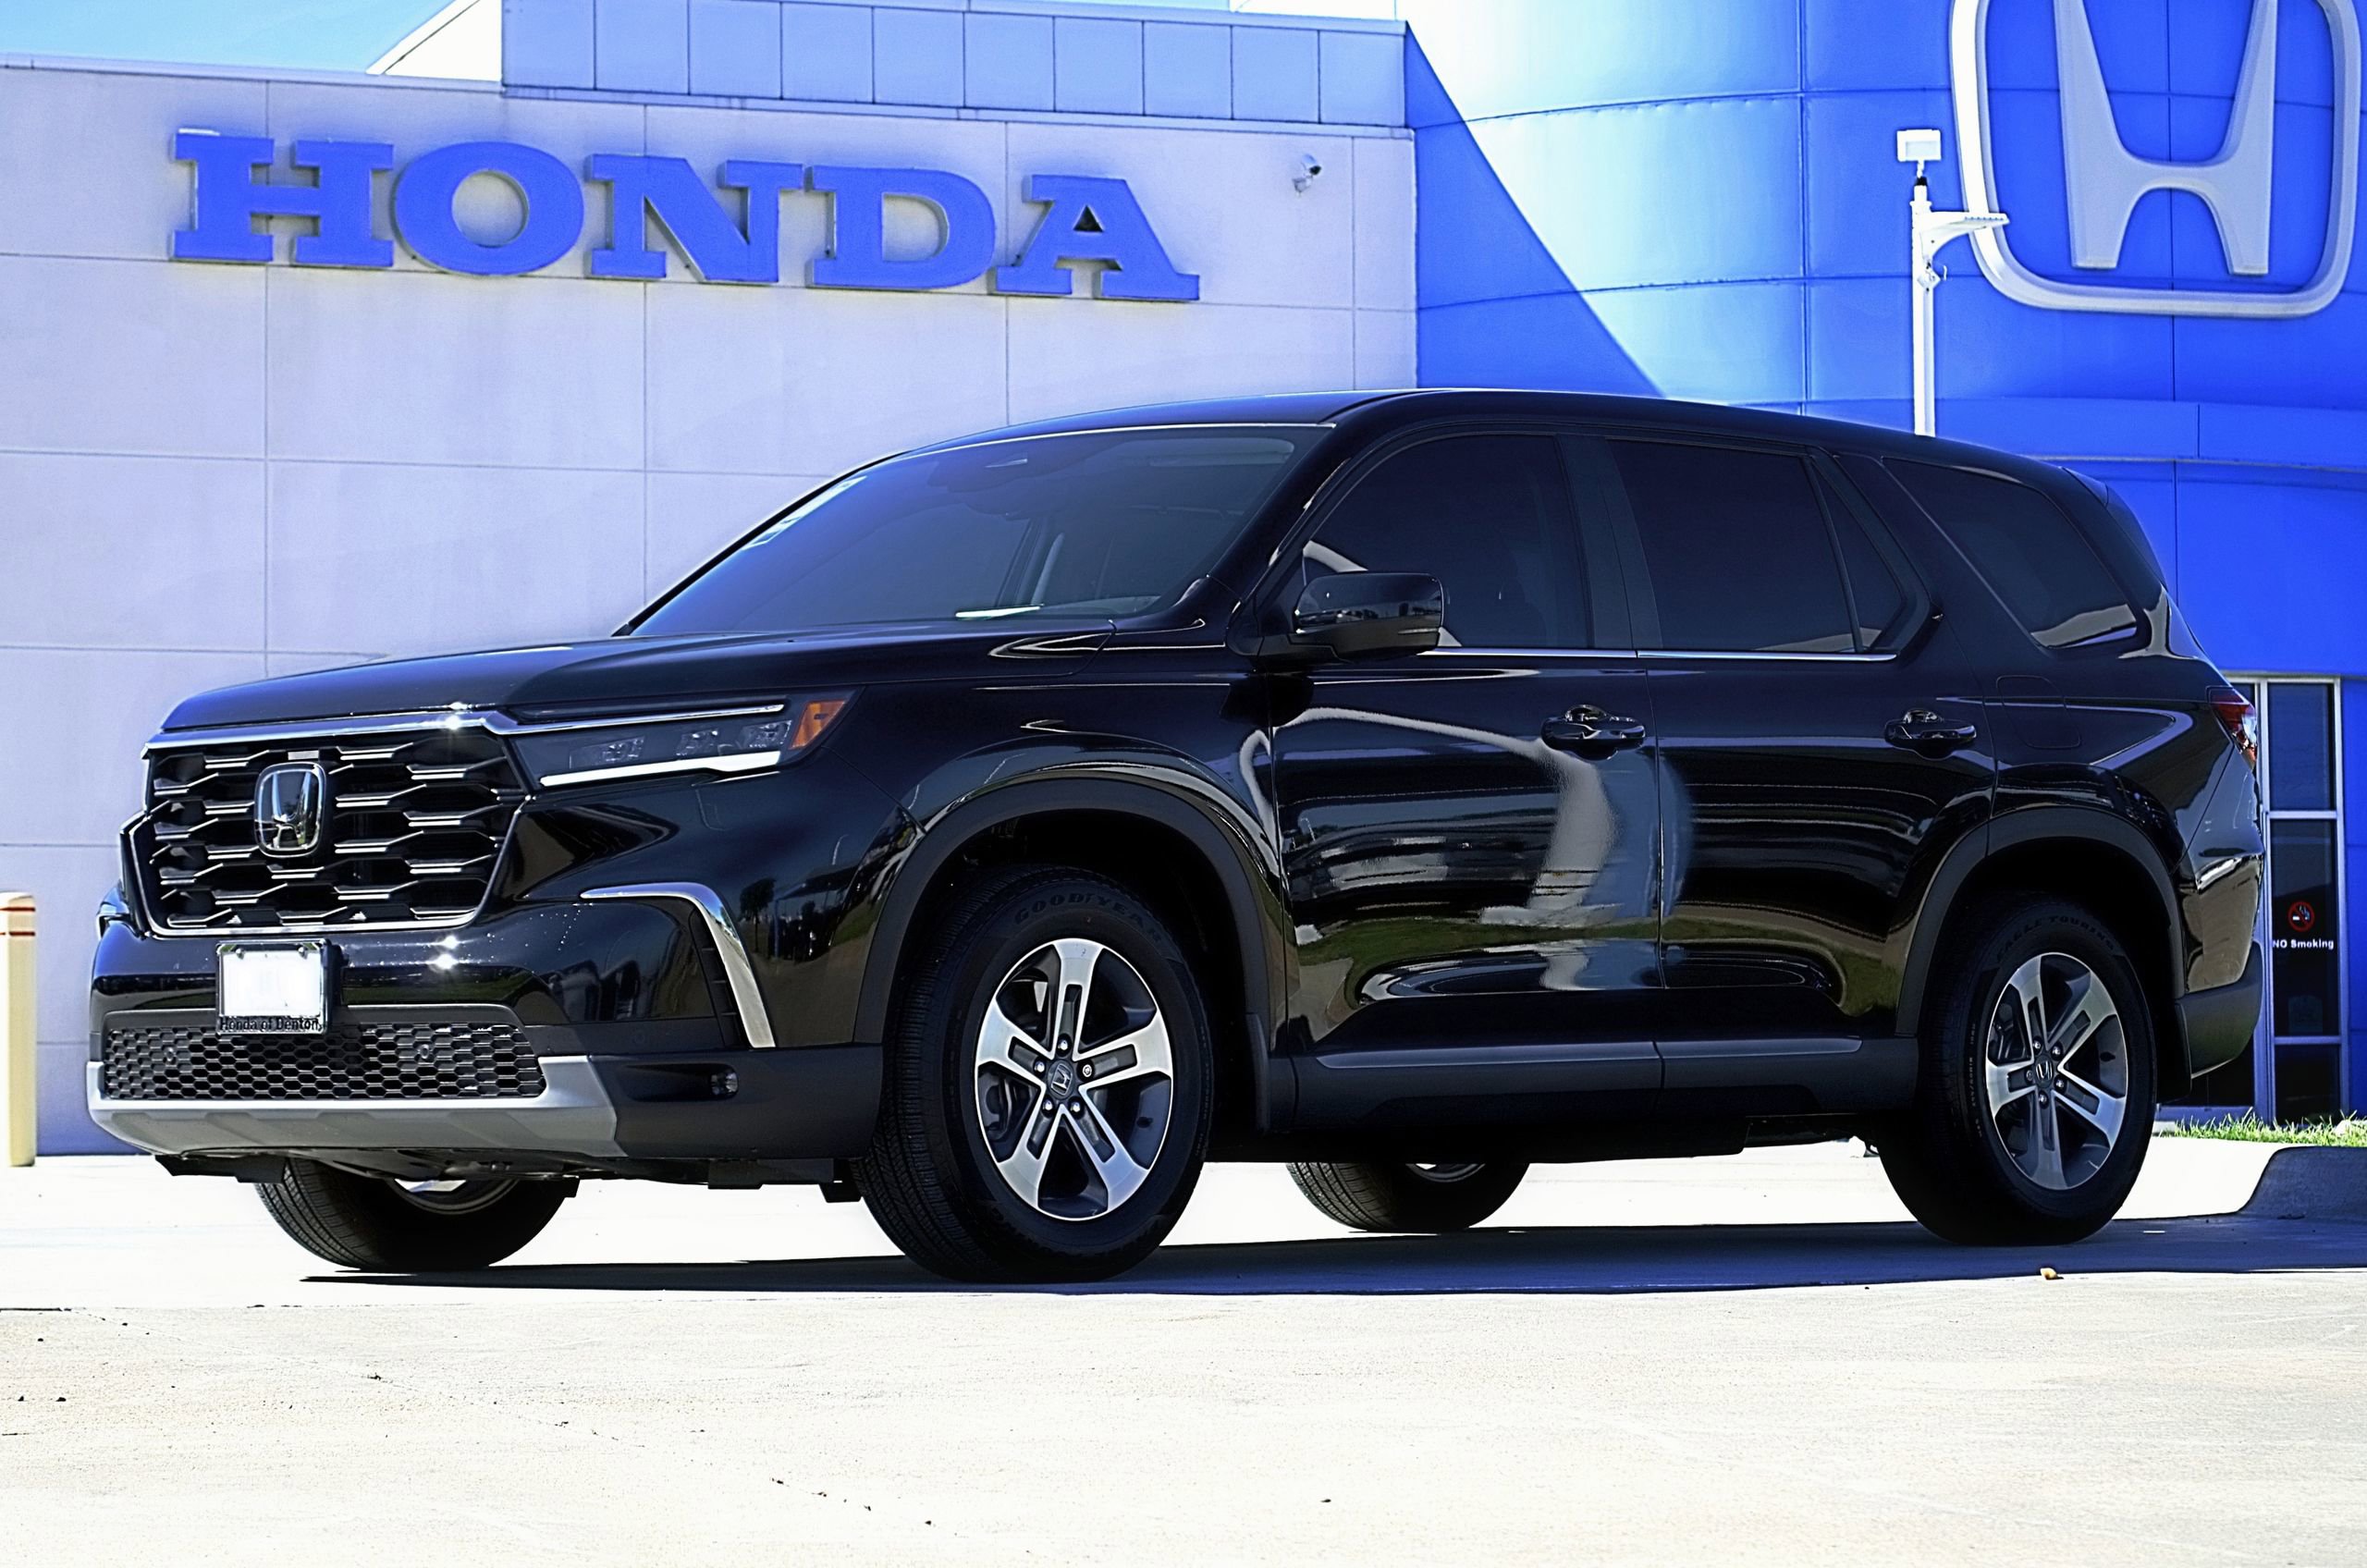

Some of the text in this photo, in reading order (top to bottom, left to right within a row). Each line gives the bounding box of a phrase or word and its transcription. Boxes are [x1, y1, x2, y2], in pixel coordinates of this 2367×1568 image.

[169, 130, 1201, 302] HONDA
[2273, 937, 2335, 950] NO Smoking
[220, 1016, 257, 1031] Honda
[260, 1016, 273, 1032] of
